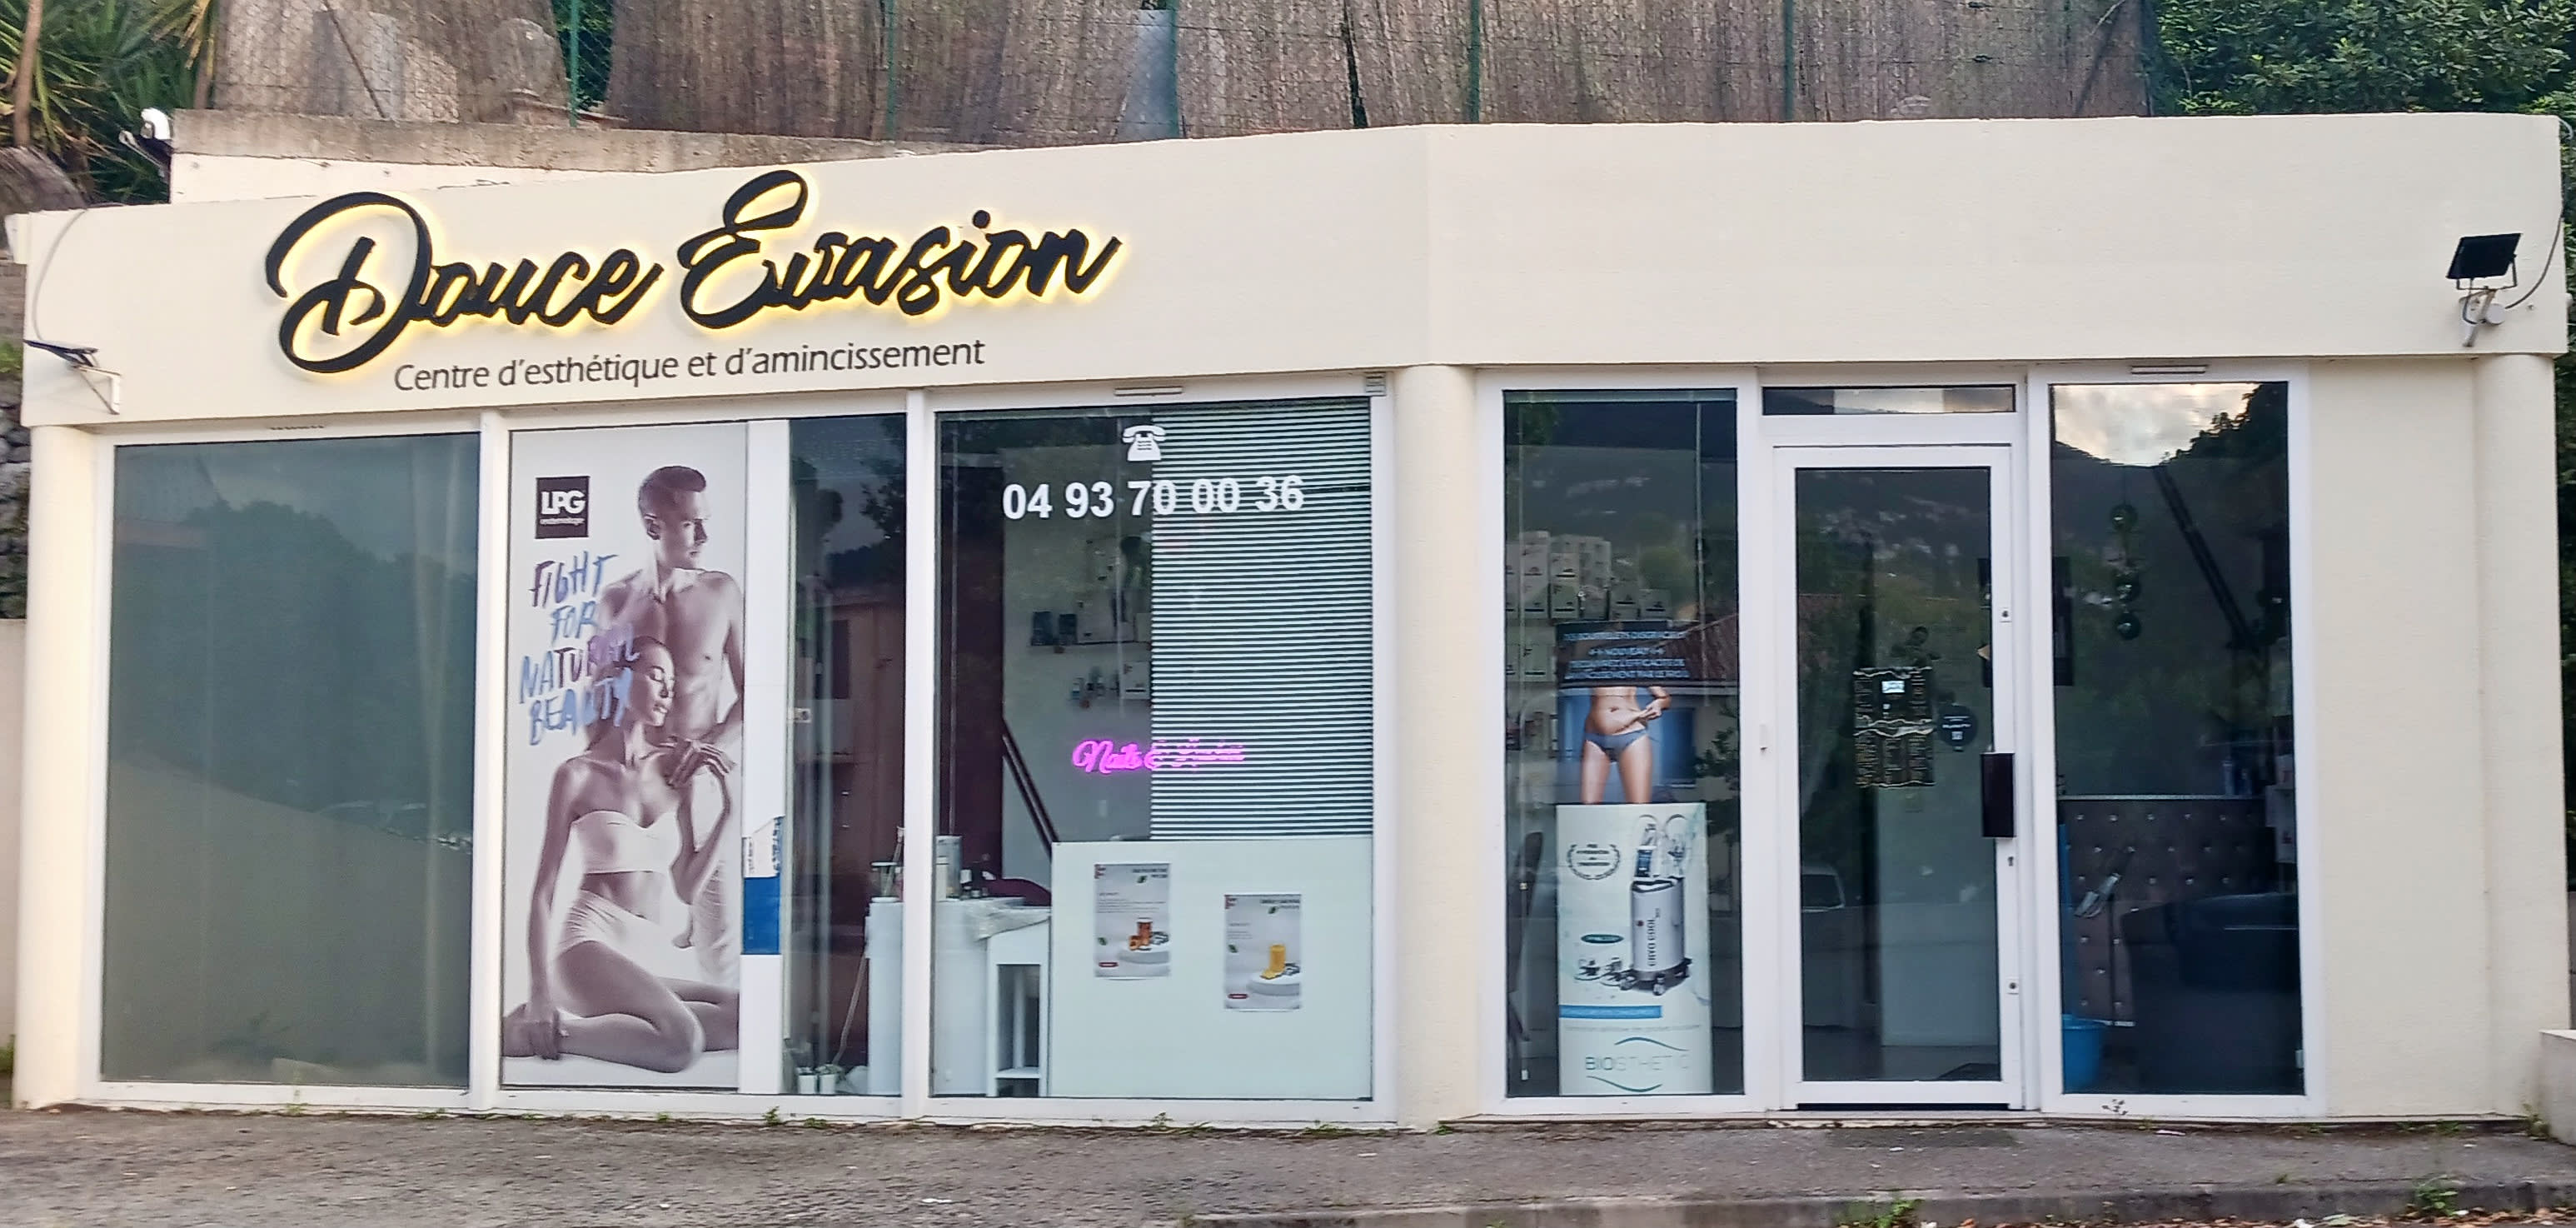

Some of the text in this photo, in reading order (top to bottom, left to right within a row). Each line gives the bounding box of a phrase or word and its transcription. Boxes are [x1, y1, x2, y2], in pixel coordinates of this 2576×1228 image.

[265, 169, 1123, 373] Douce Evasion
[394, 364, 490, 391] Centre
[687, 352, 717, 377] et
[541, 490, 586, 515] LPG
[1003, 475, 1304, 519] 04 93 70 00 36
[529, 551, 619, 608] FIGHT
[551, 601, 600, 643] FOR
[530, 667, 633, 746] BEAUTY
